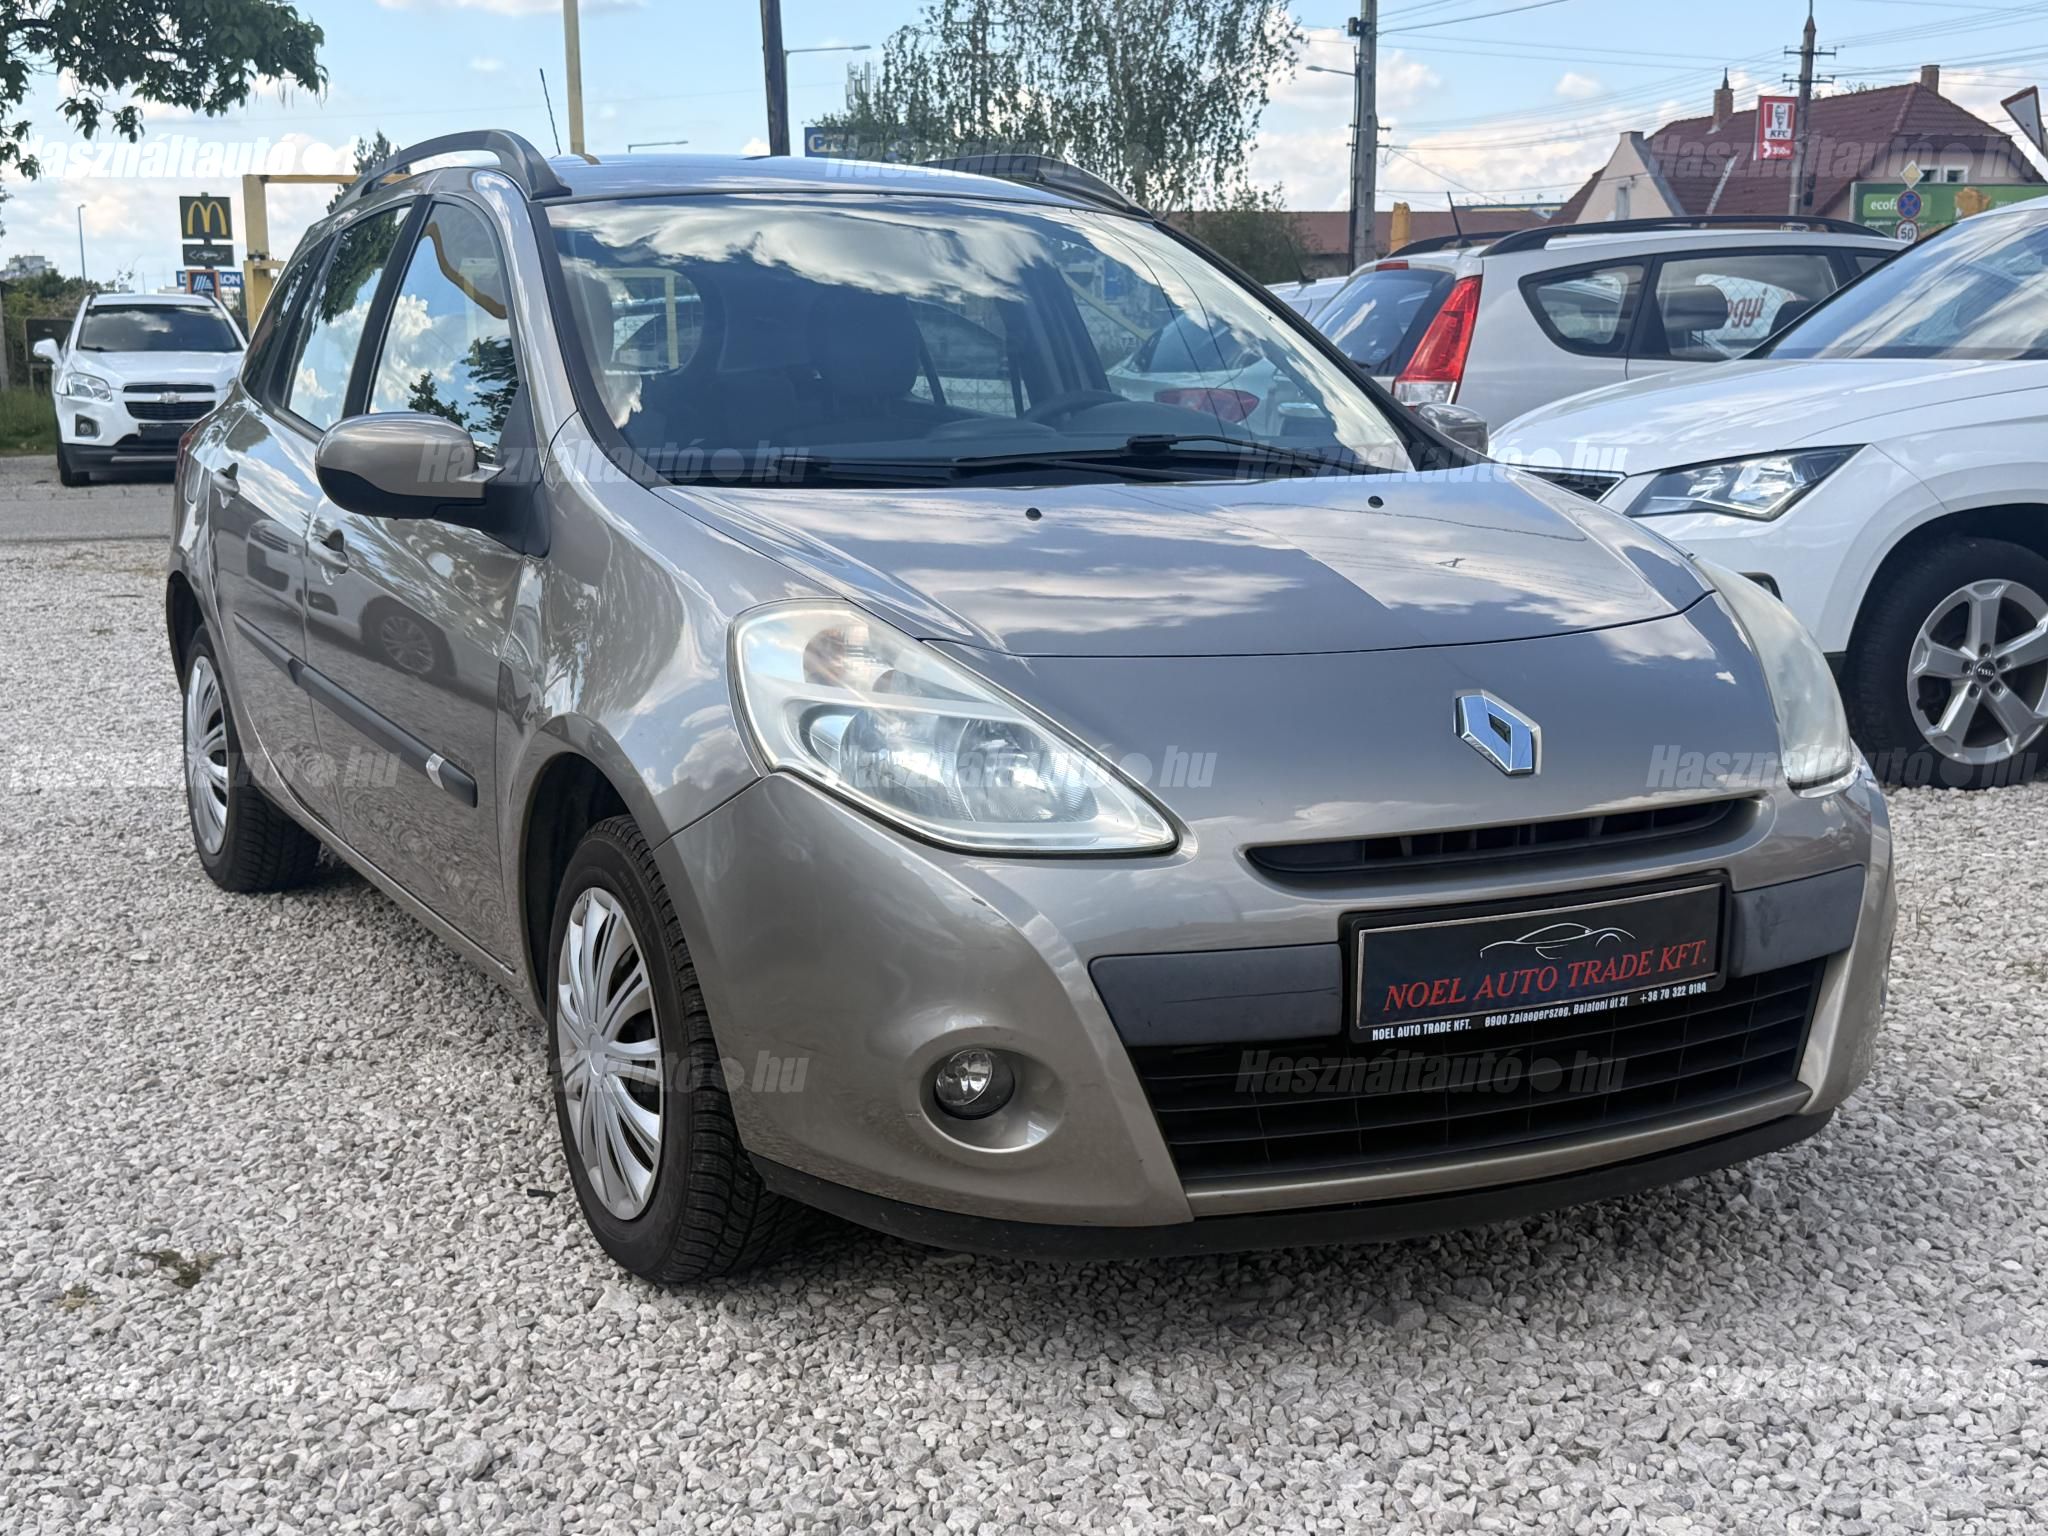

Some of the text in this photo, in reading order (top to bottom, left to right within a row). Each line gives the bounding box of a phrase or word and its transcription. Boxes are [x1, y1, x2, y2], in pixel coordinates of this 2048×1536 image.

[1770, 130, 1789, 138] KFC
[1901, 227, 1914, 241] 50
[1383, 939, 1707, 1011] NOEL AUTO TRADE KFT.
[1372, 1028, 1395, 1041] NOEL
[1397, 1026, 1421, 1038] AUTO
[1423, 1022, 1451, 1035] TRADE
[1453, 1019, 1472, 1032] KFT.
[1484, 1014, 1507, 1028] 8900
[1573, 999, 1608, 1015] Balatoni
[1619, 996, 1629, 1007] 21
[1660, 989, 1670, 1000] 70
[1672, 986, 1687, 998] 322
